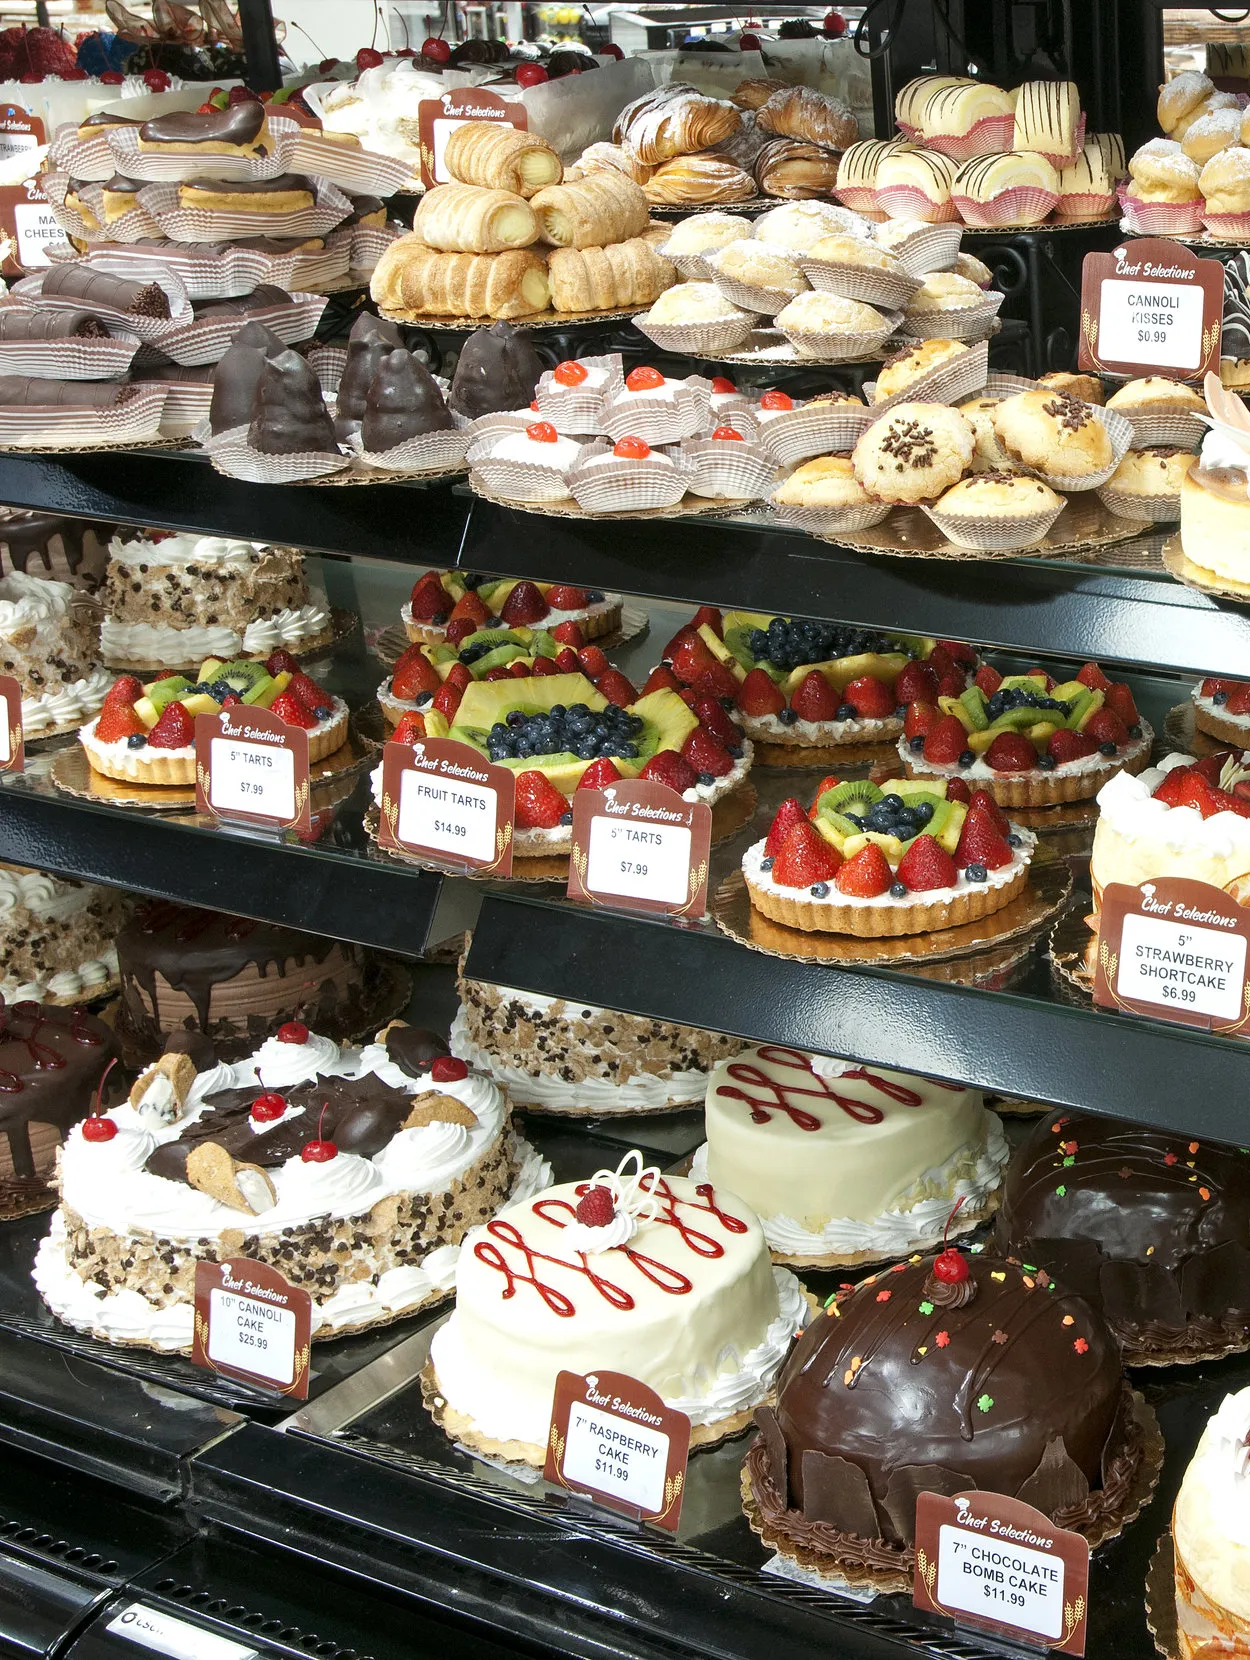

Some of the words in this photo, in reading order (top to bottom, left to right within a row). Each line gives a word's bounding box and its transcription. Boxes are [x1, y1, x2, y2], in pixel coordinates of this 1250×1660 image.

[443, 104, 463, 117] Chef
[465, 104, 506, 118] Selections
[0, 143, 32, 153] TRAWBERRY
[27, 189, 48, 200] Che
[1115, 260, 1142, 276] Chef
[1143, 262, 1196, 280] Selections
[1127, 294, 1180, 308] CANNOLI
[1132, 311, 1174, 326] KISSES
[1137, 329, 1167, 343] $0.99
[221, 721, 243, 737] Chef
[243, 725, 286, 744] Selections
[243, 752, 273, 768] TARTS
[414, 754, 439, 770] Chef
[439, 760, 489, 782] Selections
[240, 781, 264, 796] $7.99
[417, 785, 449, 802] FRUIT
[450, 792, 487, 811] TARTS
[604, 800, 631, 815] Chef
[631, 803, 684, 823] Selections
[434, 819, 467, 838] $14.99
[625, 829, 662, 845] TARTS
[620, 860, 648, 876] $7.99
[1141, 897, 1173, 916] Chef
[1173, 903, 1238, 928] Selections
[1135, 945, 1235, 975] STRAWBERRY
[1139, 963, 1227, 991] SHORTCAKE
[1161, 985, 1197, 1003] $6.99
[222, 1274, 244, 1292] Chef
[243, 1280, 289, 1305] Selections
[238, 1300, 283, 1324] CANNOLI
[236, 1315, 265, 1334] CAKE
[238, 1331, 269, 1351] $25.99
[585, 1387, 612, 1407] Chef
[610, 1396, 663, 1427] Selections
[589, 1422, 660, 1460] RASPBERRY
[597, 1443, 631, 1466] CAKE
[594, 1458, 630, 1483] $11.99
[956, 1510, 989, 1531] Chef
[989, 1519, 1054, 1550] Selections
[971, 1547, 1060, 1583] CHOCOLATE
[962, 1561, 1005, 1584] BOMB
[1008, 1574, 1048, 1597] CAKE
[983, 1584, 1027, 1608] $11.99
